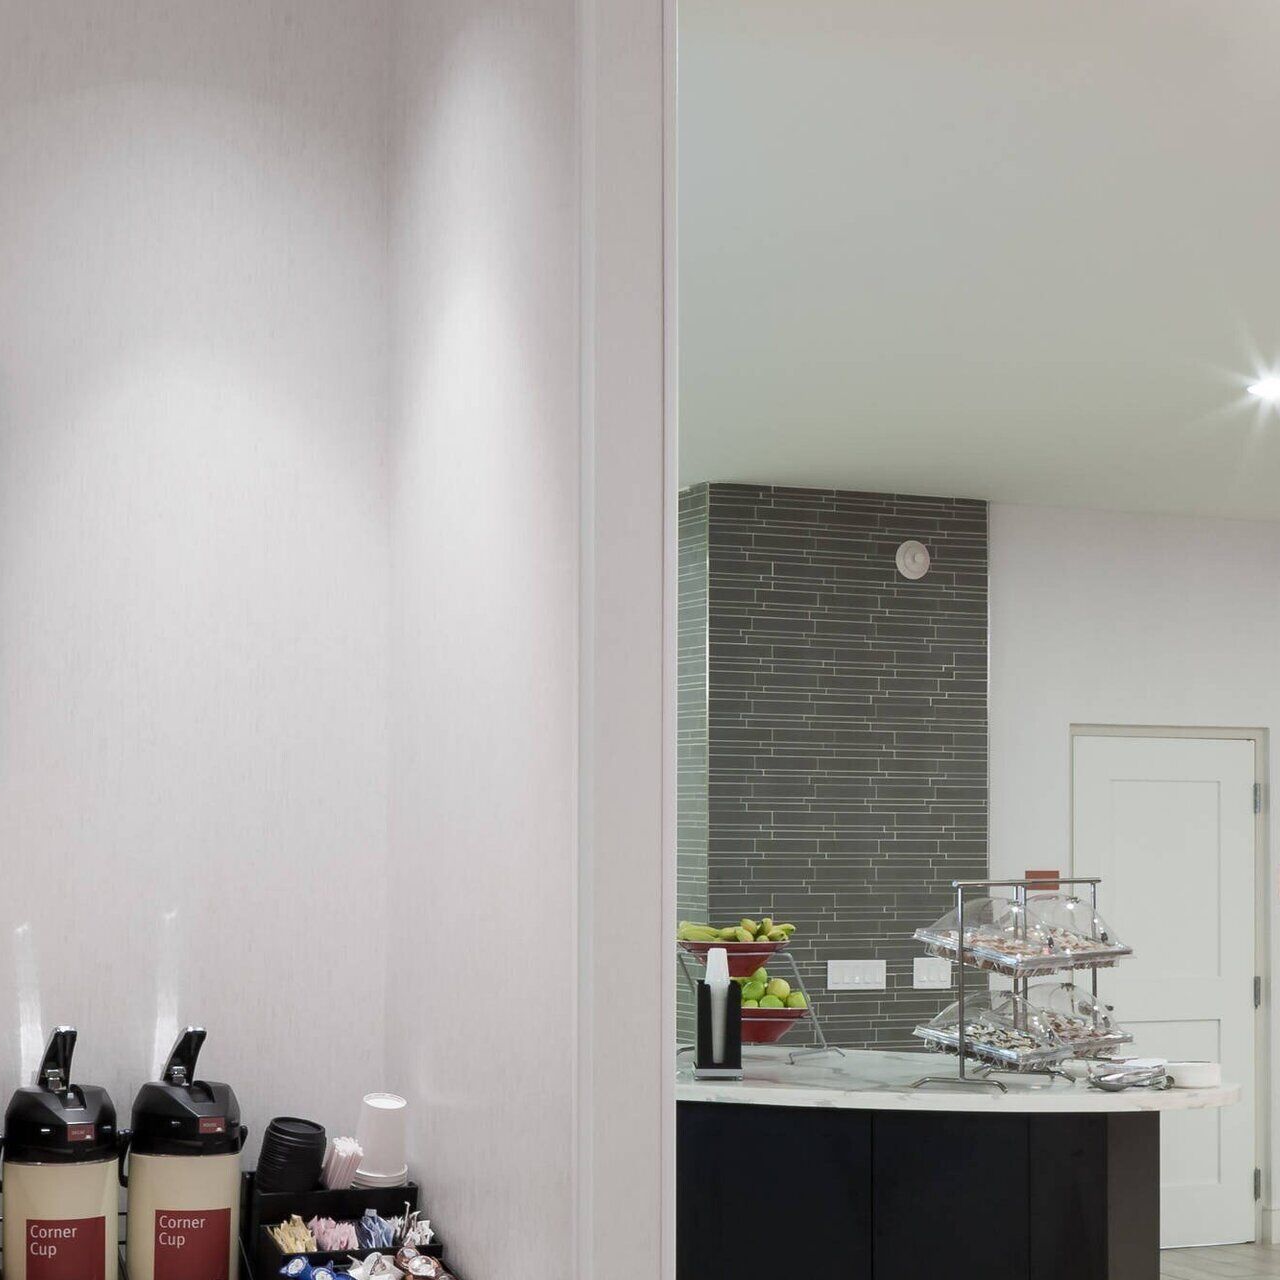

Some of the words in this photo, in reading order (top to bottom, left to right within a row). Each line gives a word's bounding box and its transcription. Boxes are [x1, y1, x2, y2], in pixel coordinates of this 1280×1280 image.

[159, 1215, 206, 1230] Corner
[30, 1224, 78, 1239] Corner
[158, 1232, 186, 1249] Cup
[30, 1242, 57, 1258] Cup
